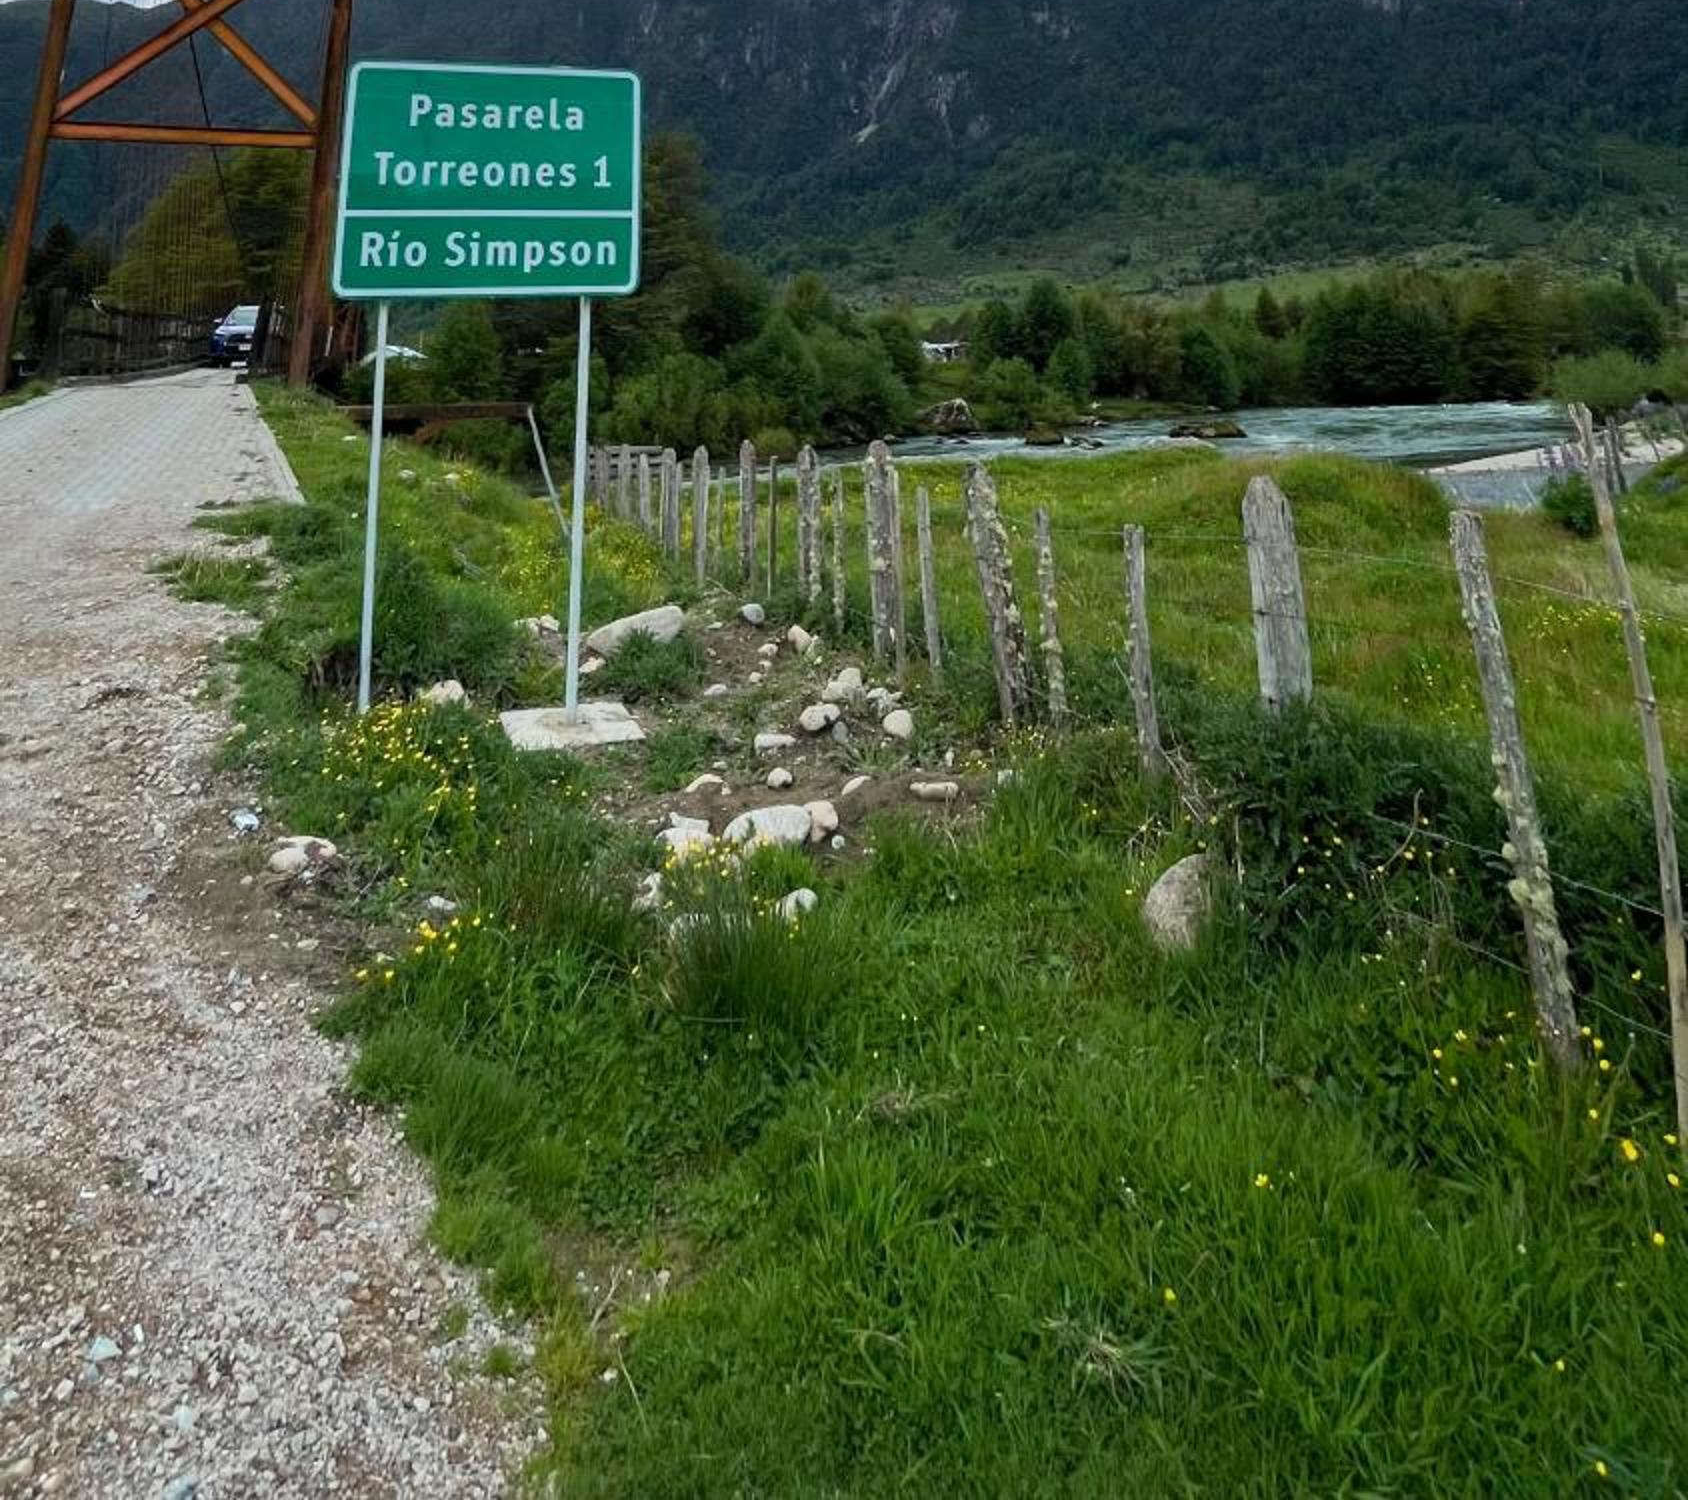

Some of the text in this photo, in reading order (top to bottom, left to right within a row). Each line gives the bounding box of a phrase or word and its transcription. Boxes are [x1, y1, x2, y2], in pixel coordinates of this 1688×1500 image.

[409, 93, 584, 131] Pasarela
[374, 151, 612, 188] Torreones 1
[359, 230, 617, 273] Río Simpson
